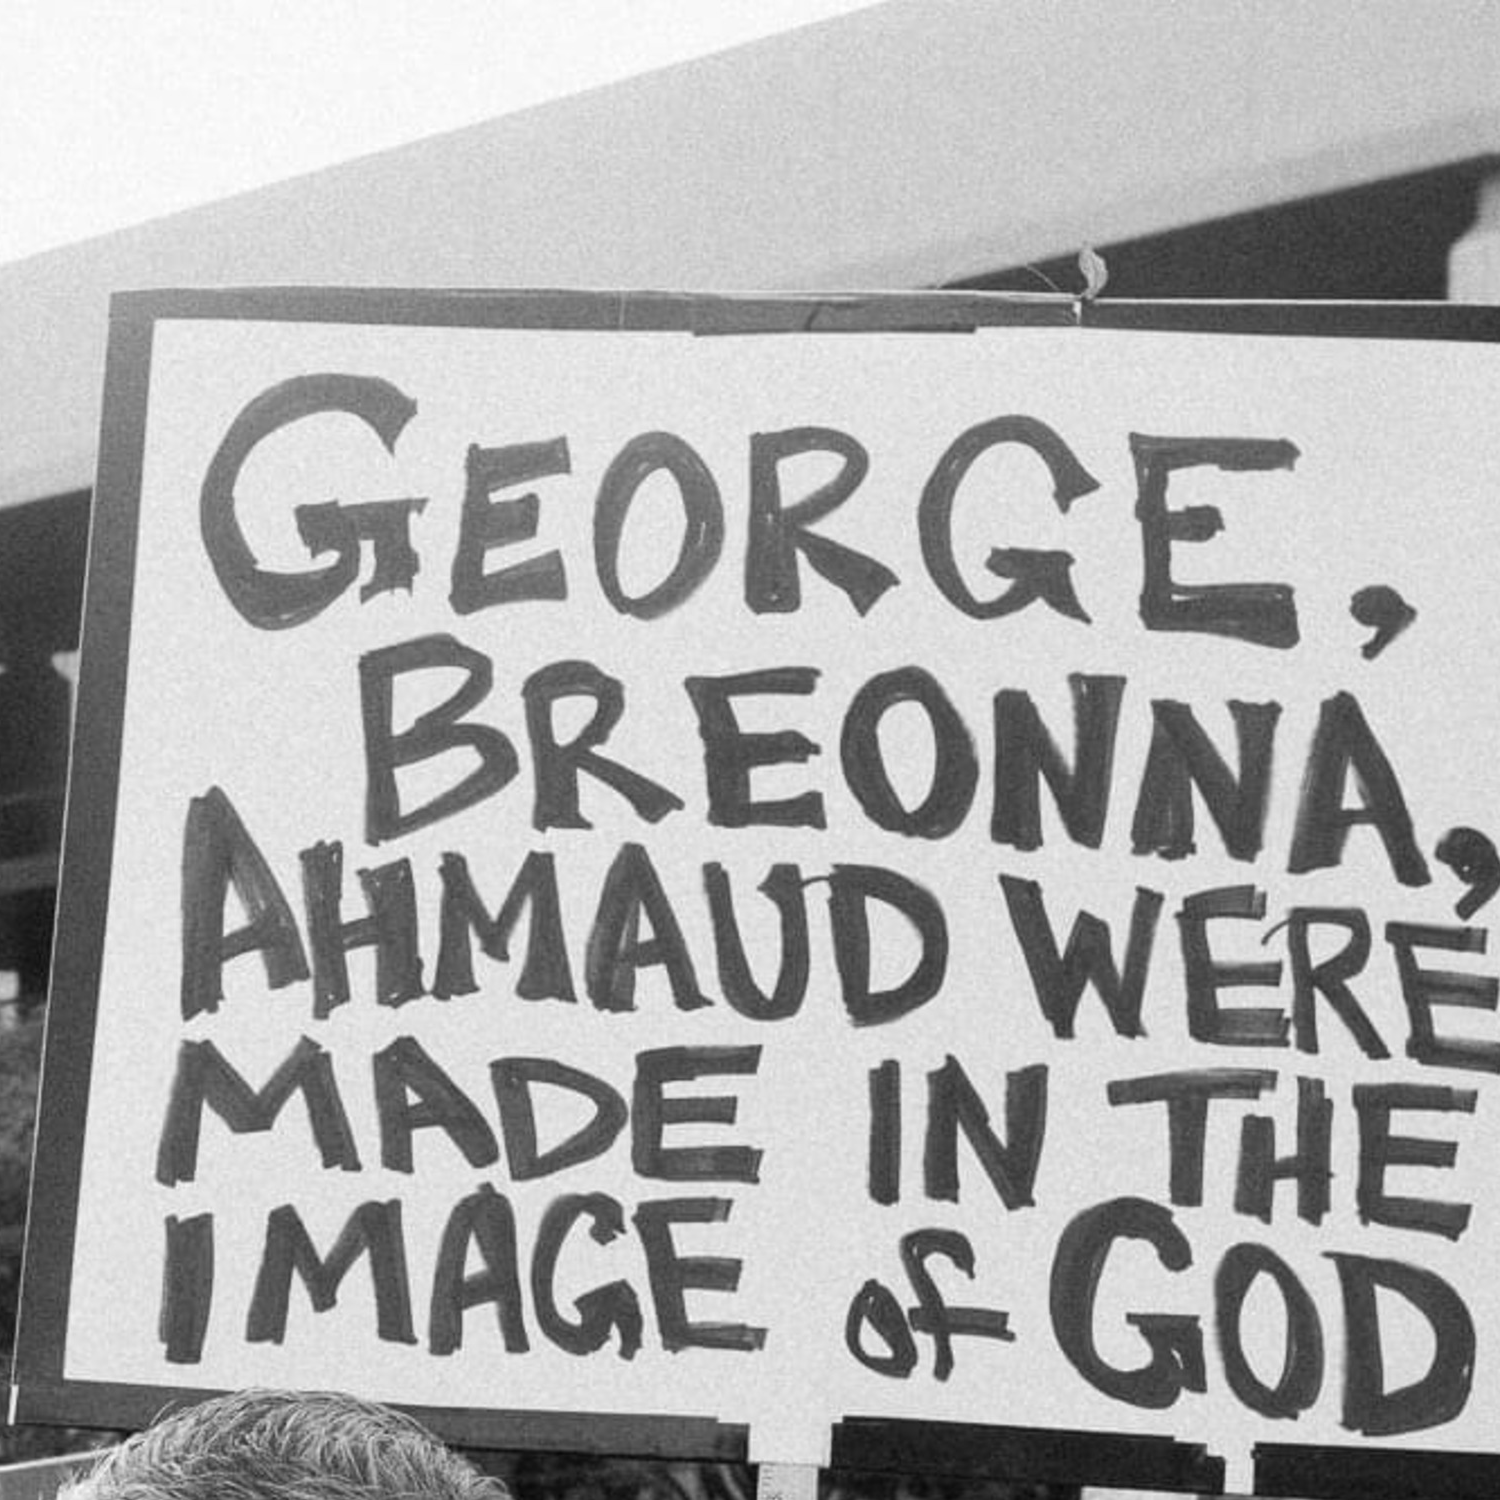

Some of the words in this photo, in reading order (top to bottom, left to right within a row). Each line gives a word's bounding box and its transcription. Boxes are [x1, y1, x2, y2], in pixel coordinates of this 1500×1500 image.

[201, 375, 1416, 660] GEORGE,
[358, 634, 1500, 921] BREONNA,
[181, 787, 949, 1027] AHMAUD
[999, 874, 1500, 1075] WERE
[156, 1036, 763, 1187] MADE
[868, 1054, 1048, 1211] IN
[1107, 1069, 1478, 1242] THE
[159, 1182, 767, 1364] IMAGE
[1049, 1197, 1476, 1437] GOD
